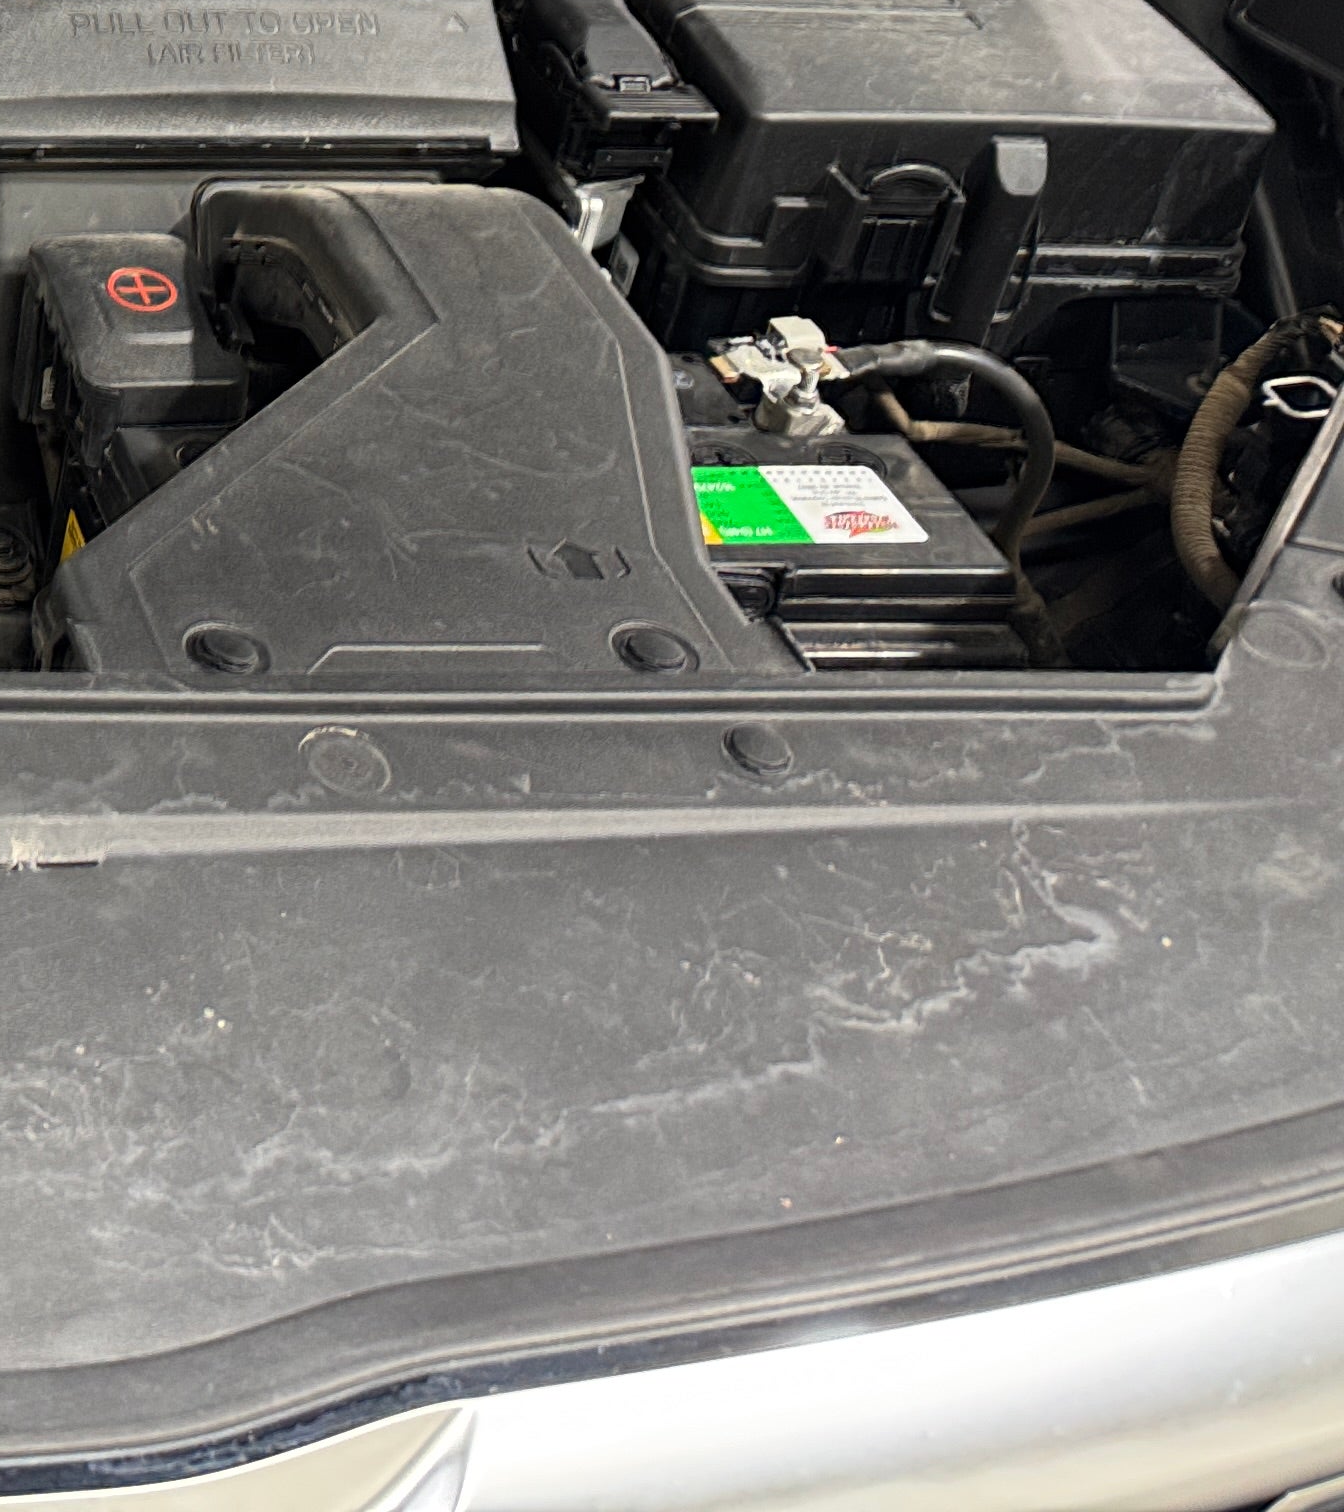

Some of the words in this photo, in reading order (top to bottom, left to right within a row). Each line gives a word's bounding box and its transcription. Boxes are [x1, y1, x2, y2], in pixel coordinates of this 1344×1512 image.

[68, 8, 154, 37] PULL
[163, 7, 229, 35] OUT
[235, 7, 282, 35] TO
[290, 8, 381, 37] OPEN
[146, 39, 205, 66] (AIR
[212, 39, 317, 65] FILTER)
